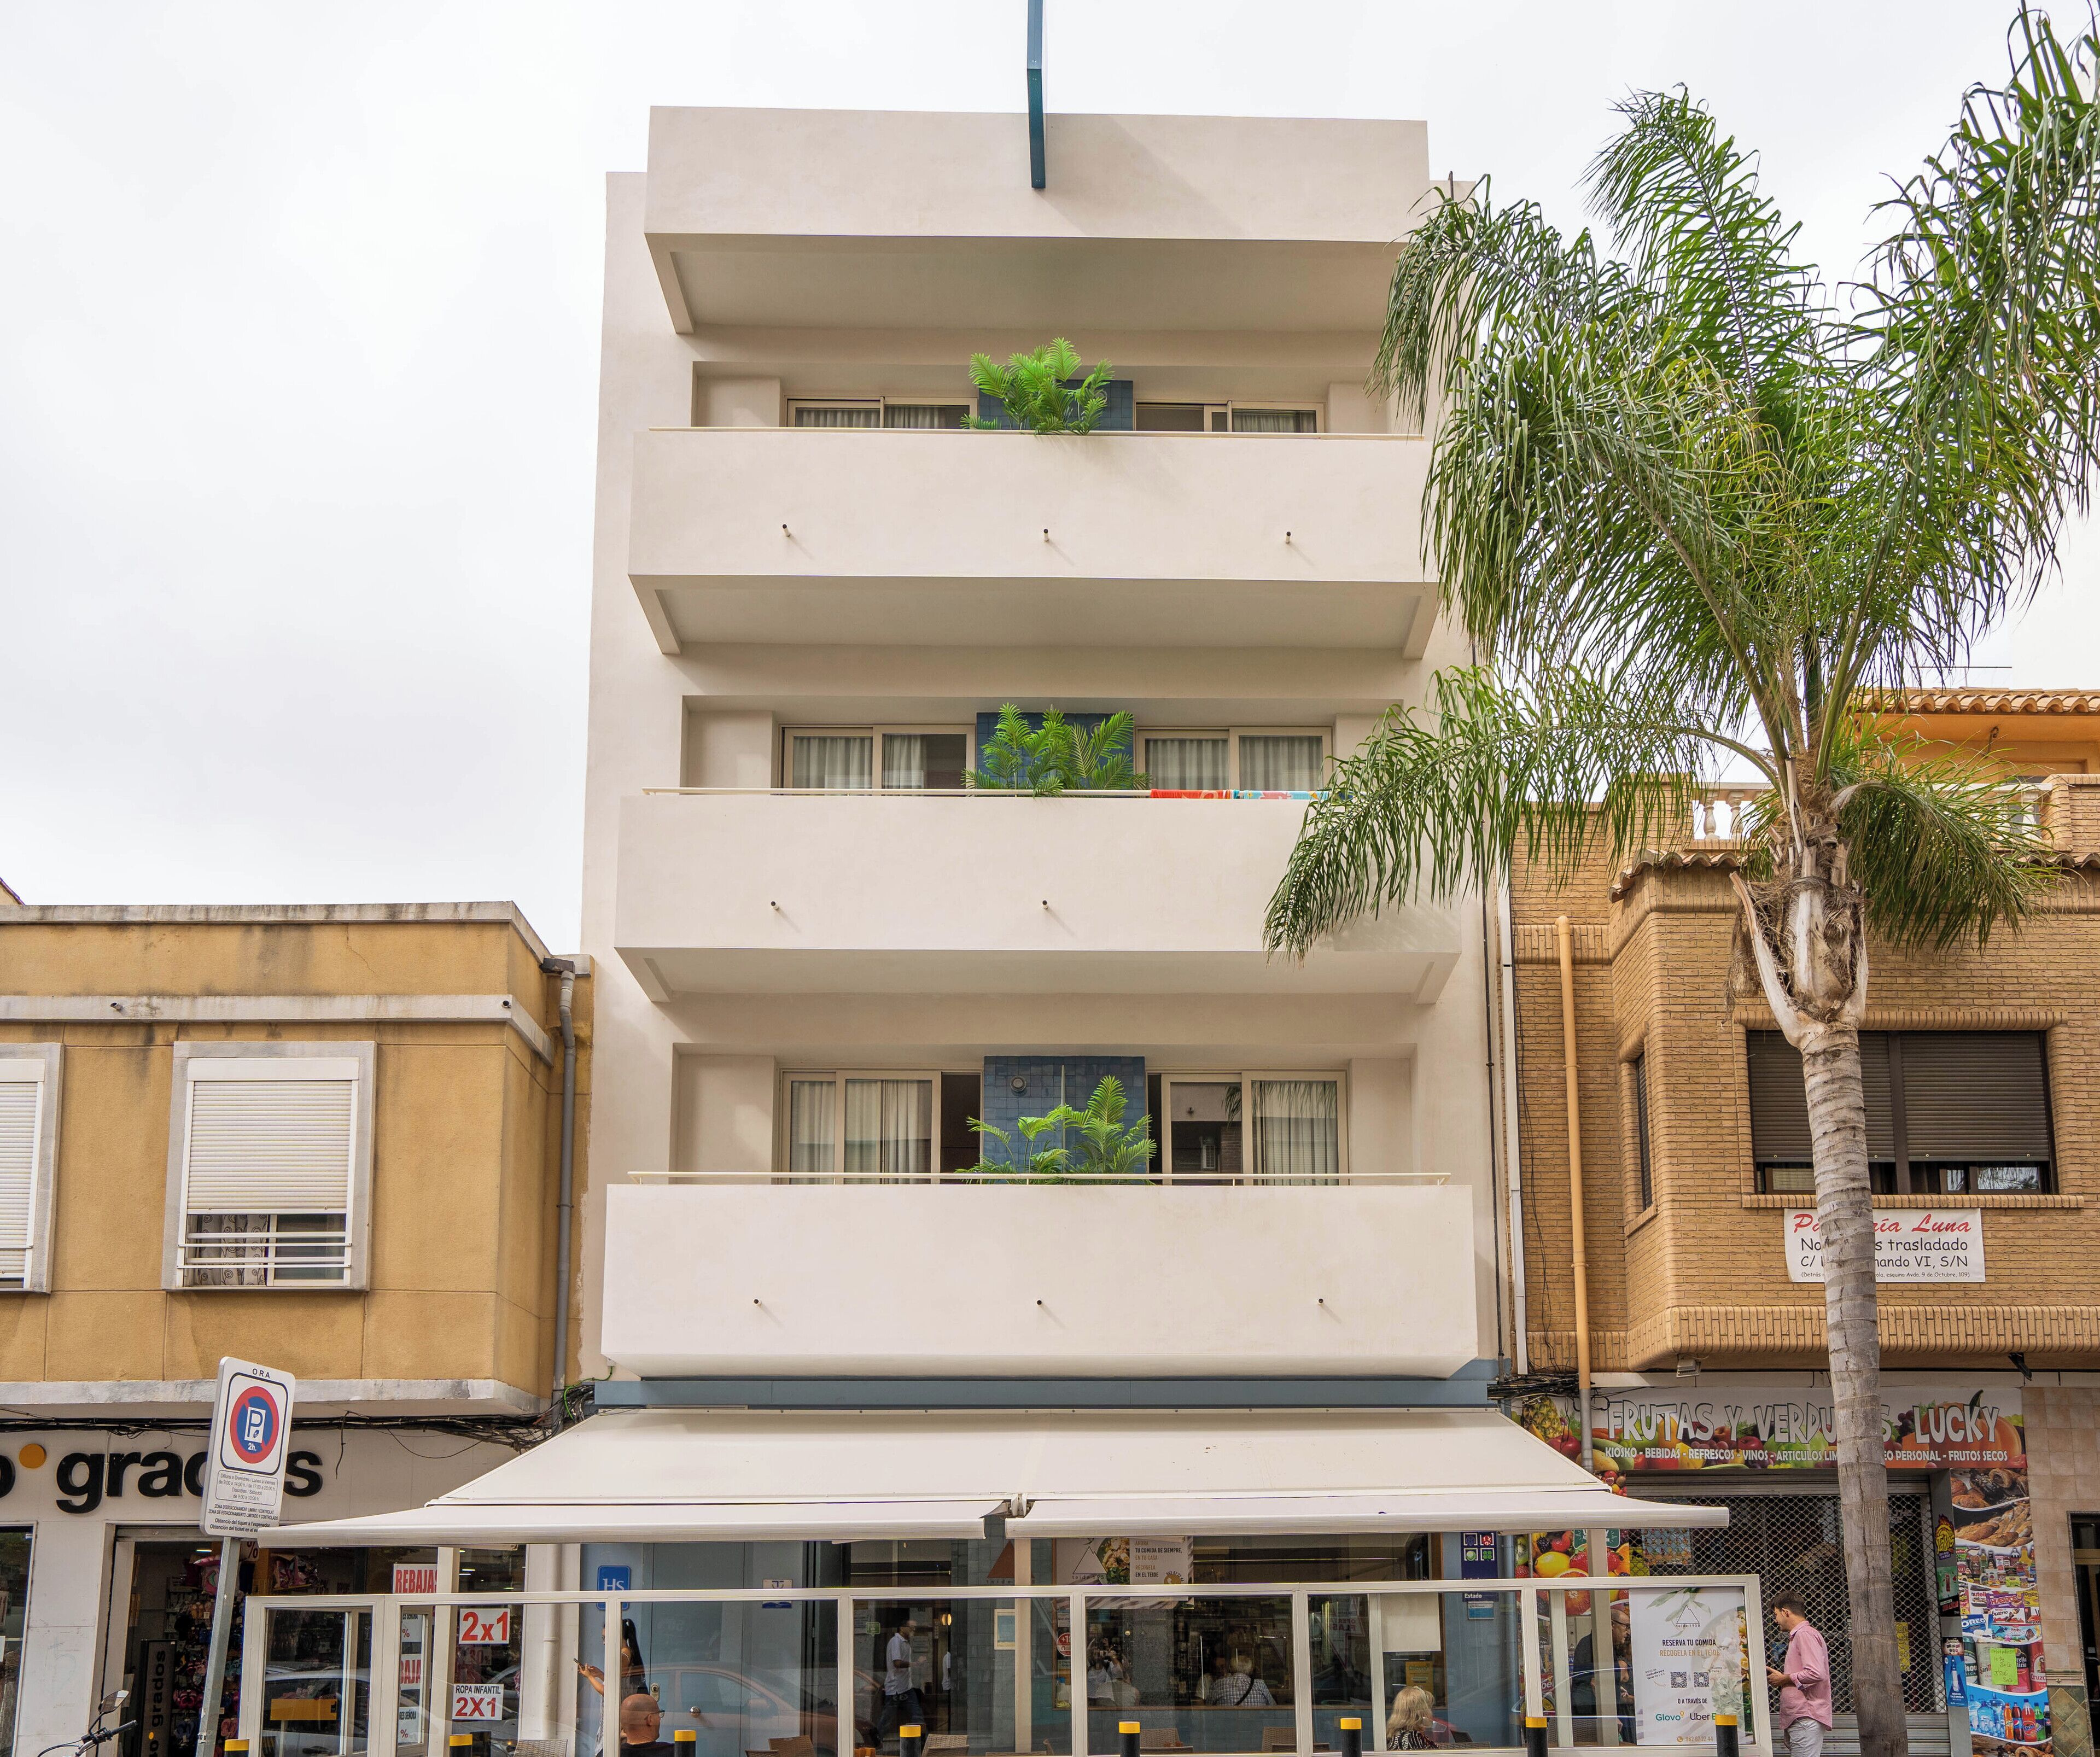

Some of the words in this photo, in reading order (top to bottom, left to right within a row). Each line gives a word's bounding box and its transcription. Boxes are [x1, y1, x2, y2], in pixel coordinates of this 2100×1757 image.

[1911, 1213, 1971, 1233] Luna
[1888, 1238, 1968, 1251] trasladado
[1801, 1255, 1815, 1267] C/
[1875, 1256, 1910, 1267] nando
[1915, 1256, 1935, 1269] VI,
[1940, 1256, 1968, 1267] S/N
[252, 1368, 270, 1379] ORA
[247, 1409, 263, 1438] P
[1607, 1399, 1714, 1441] FRUTAS
[1724, 1405, 1743, 1441] Y
[1753, 1402, 1893, 1444] VERDUS
[1912, 1404, 2000, 1444] LUCKY
[248, 1443, 257, 1451] 2h.
[1605, 1447, 1637, 1458] KIOSKO
[1645, 1447, 1681, 1459] BEBIDAS
[1688, 1448, 1735, 1460] REFRESCOS
[1743, 1449, 1768, 1460] VINOS
[1776, 1450, 1822, 1461] ARTICULOS
[1896, 1451, 1941, 1461] PERSONAL
[1949, 1451, 1980, 1461] FRUTOS
[1983, 1451, 2008, 1462] SECOS
[1962, 1619, 1986, 1627] OREO
[456, 1685, 472, 1694] ROPA
[474, 1685, 501, 1694] INFANTIL
[455, 1697, 497, 1717] 2X1
